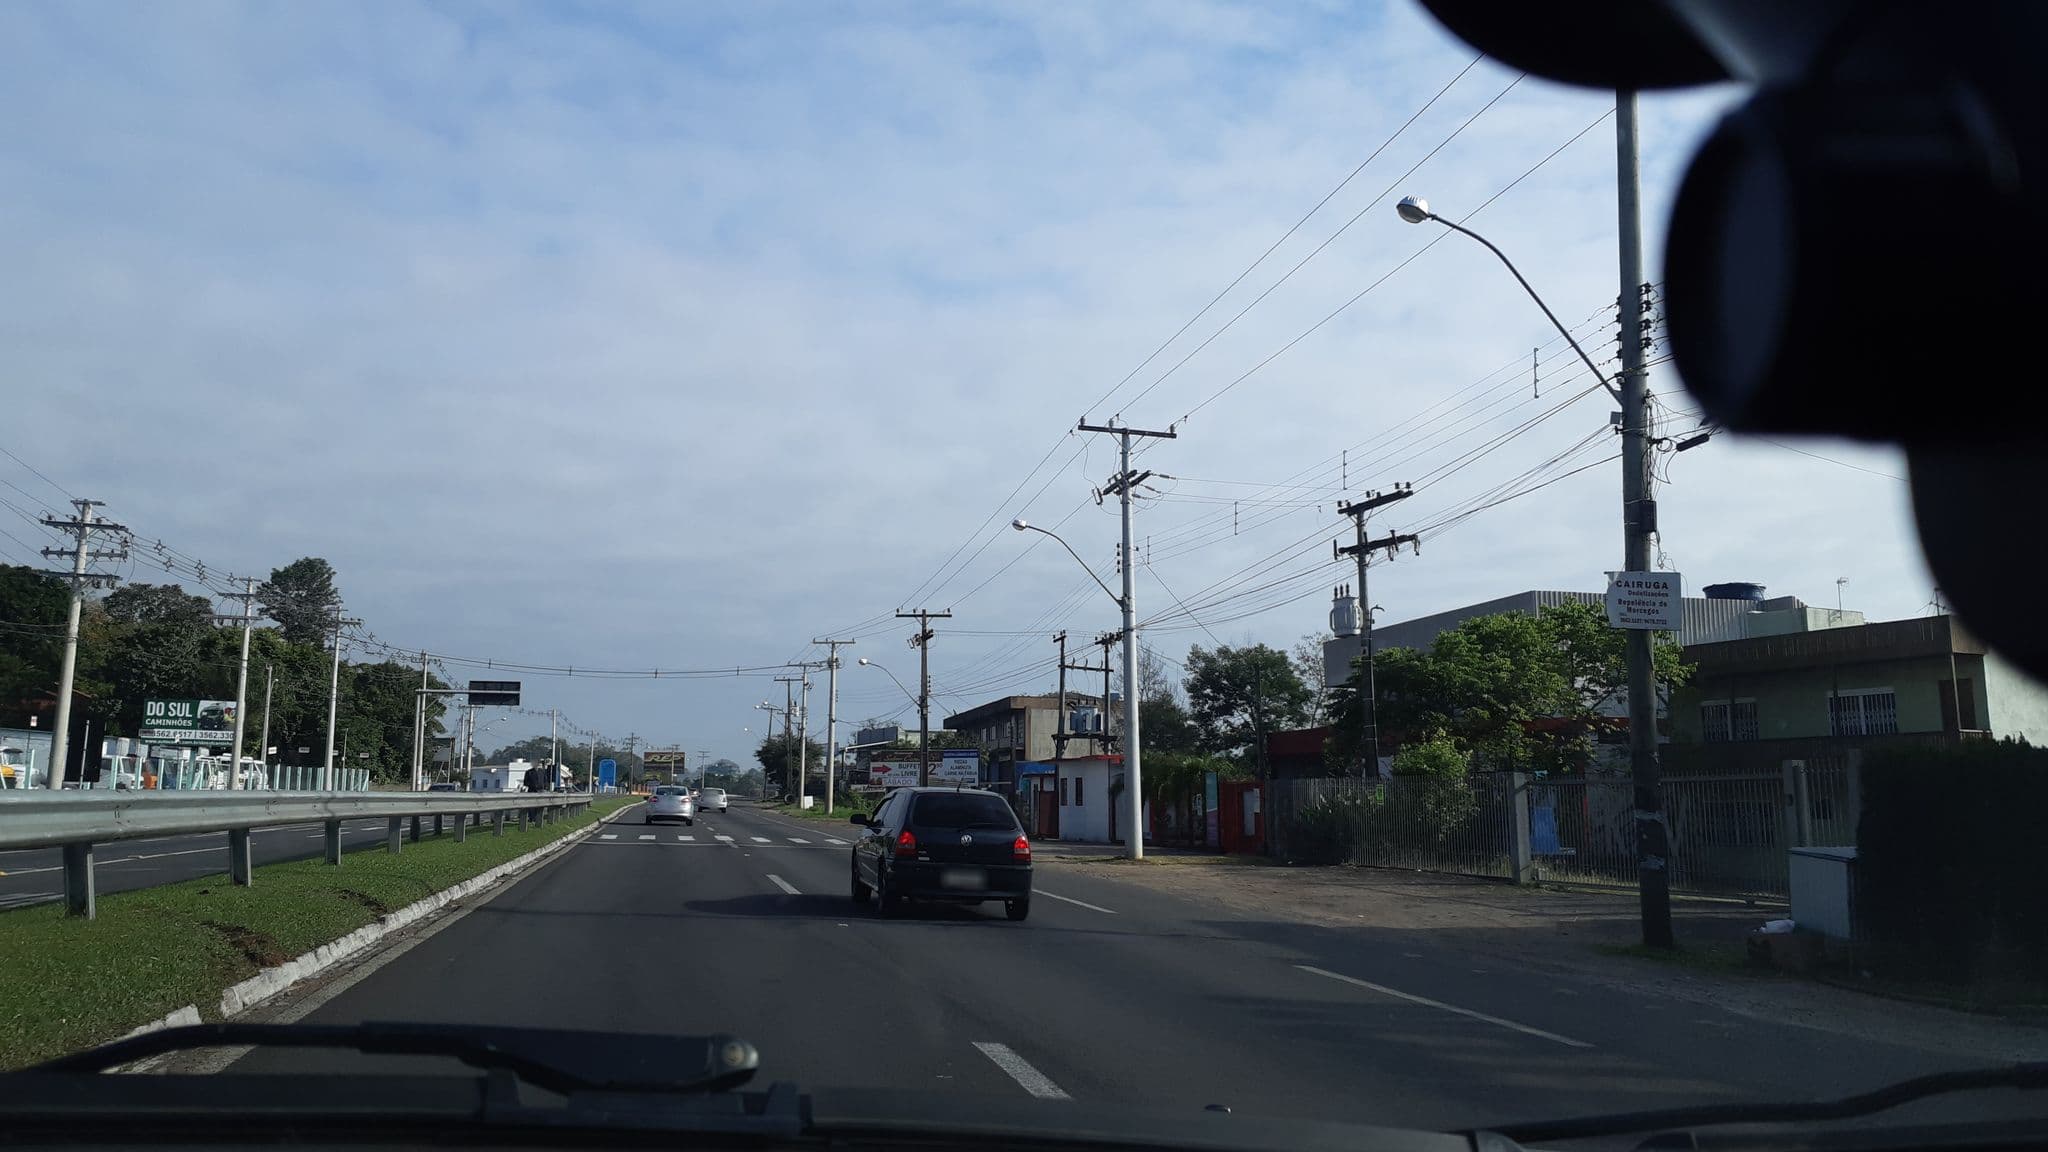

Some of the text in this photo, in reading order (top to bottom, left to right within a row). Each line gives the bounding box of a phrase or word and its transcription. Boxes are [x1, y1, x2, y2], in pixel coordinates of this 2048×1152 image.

[1616, 580, 1669, 590] CAIRUGA
[1618, 598, 1657, 607] Repelência
[1627, 606, 1660, 616] Morcegos
[146, 701, 192, 717] DO SUL
[145, 718, 192, 727] CAMINHÕES
